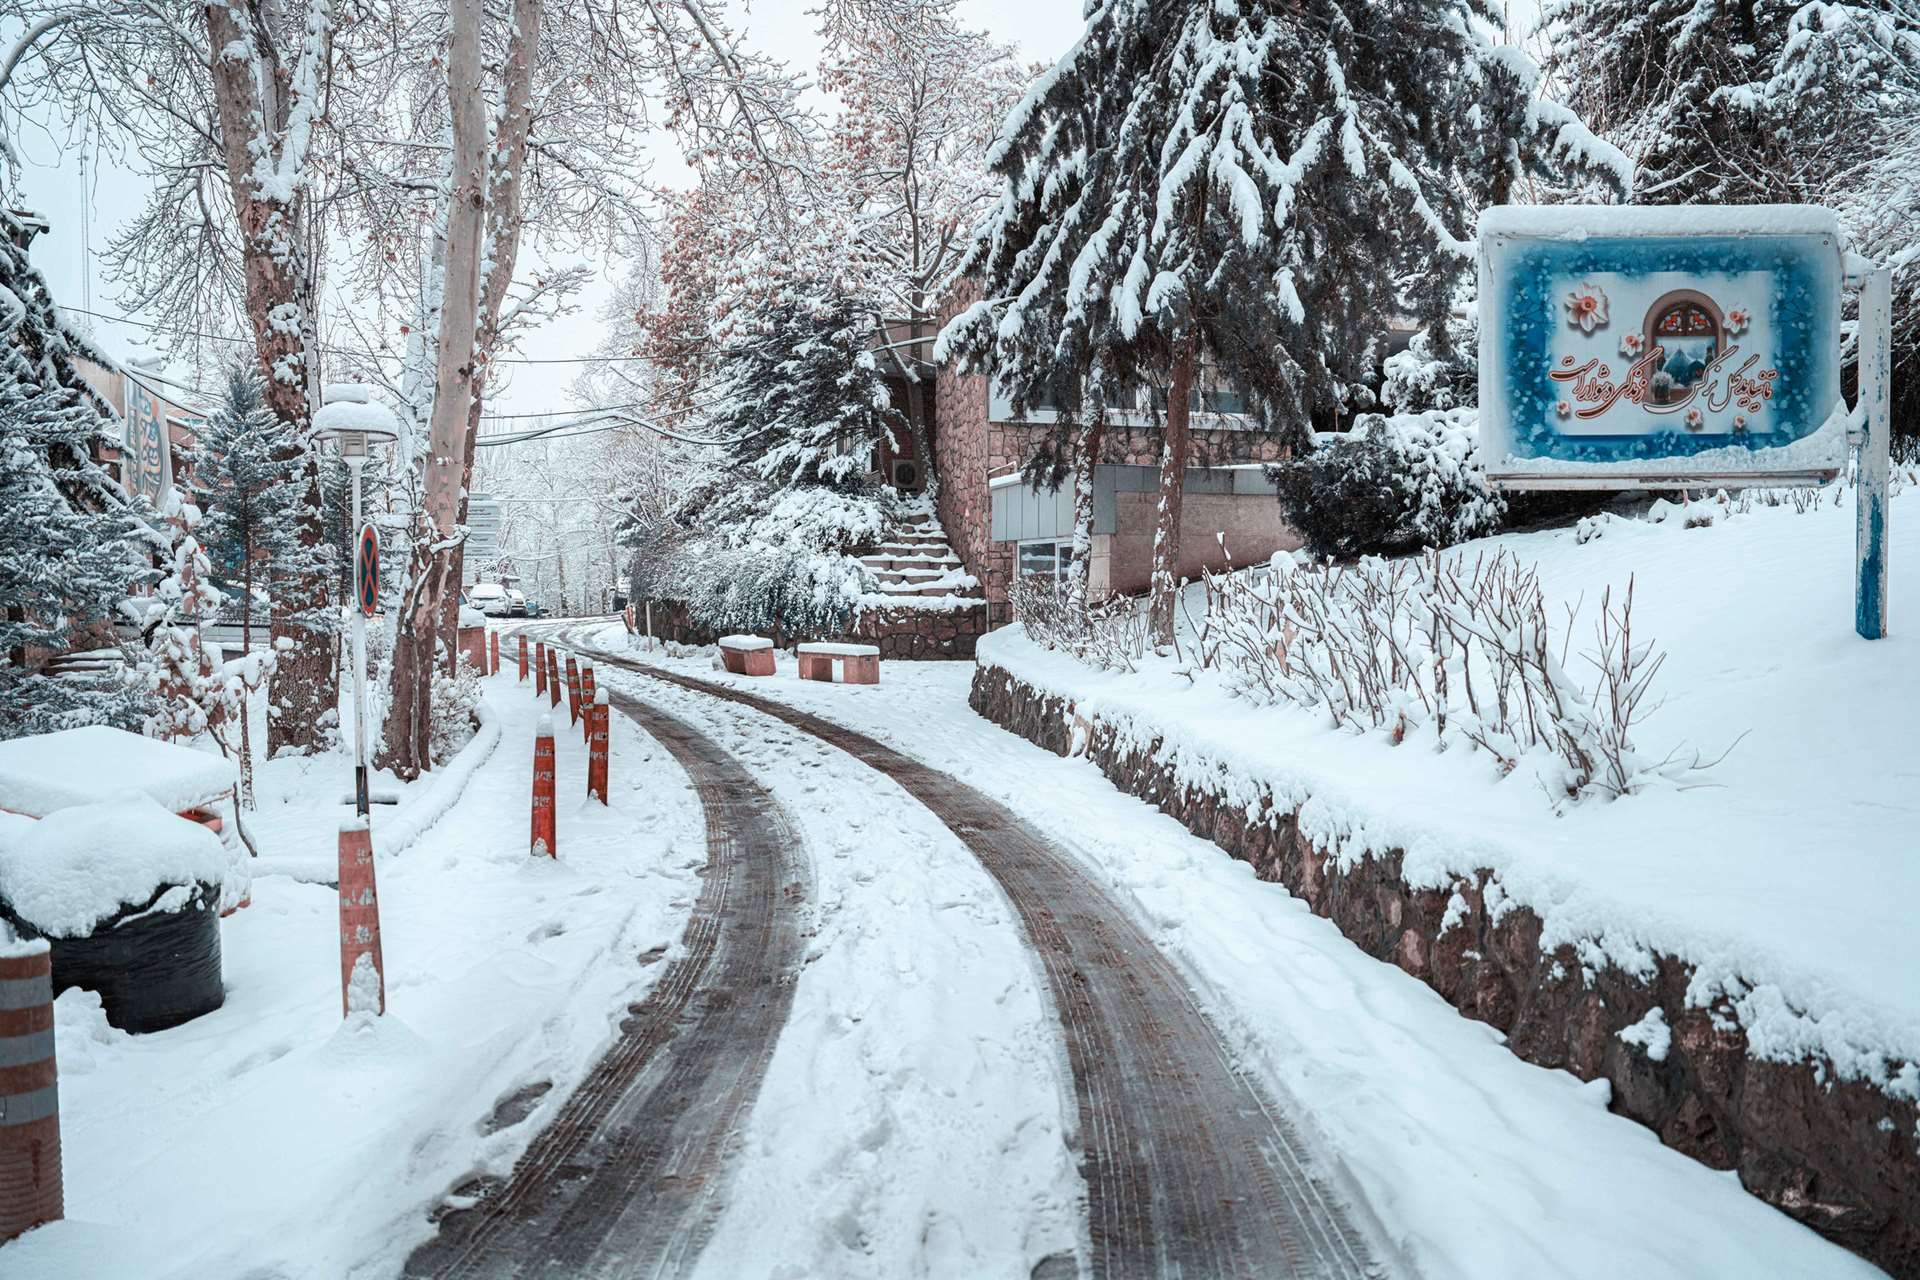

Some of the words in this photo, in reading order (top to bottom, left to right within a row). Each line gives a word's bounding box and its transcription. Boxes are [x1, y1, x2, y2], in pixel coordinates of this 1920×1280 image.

[1549, 355, 1598, 394] است
[1576, 346, 1664, 419] زندگی
[1577, 364, 1614, 401] دشوار
[1643, 345, 1739, 414] نرگس
[1708, 354, 1760, 412] گل
[1734, 370, 1767, 413] نیاید
[1762, 369, 1778, 400] تا
